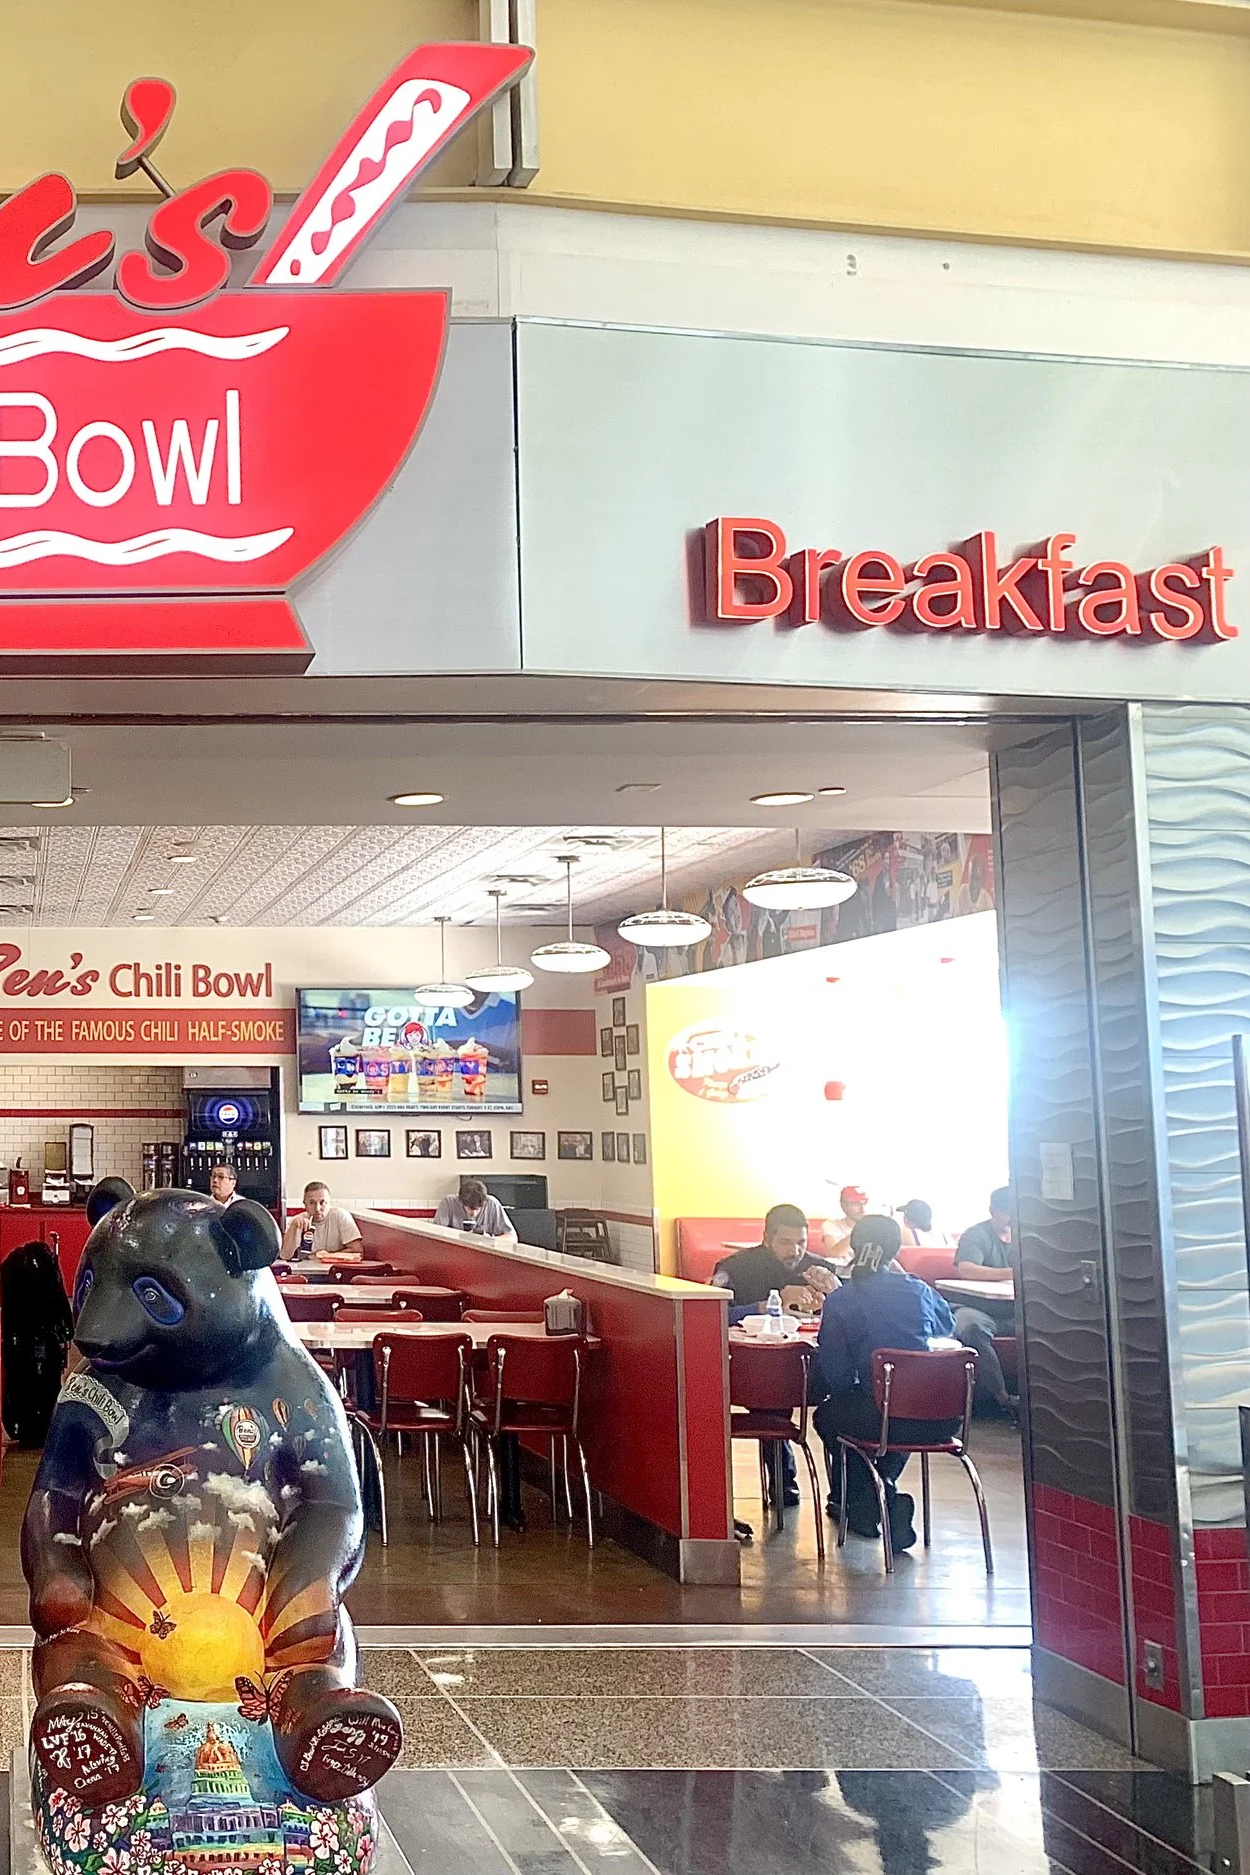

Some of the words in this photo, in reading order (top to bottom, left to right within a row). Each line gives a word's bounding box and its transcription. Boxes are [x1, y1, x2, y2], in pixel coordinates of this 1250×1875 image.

[713, 515, 1239, 642] Breakfast
[108, 961, 181, 999] Chili
[191, 962, 273, 998] Bowl
[364, 1006, 458, 1027] GOTTA
[8, 1020, 30, 1042] OF
[34, 1020, 64, 1042] THE
[71, 1020, 135, 1042] FAMOUS
[140, 1020, 179, 1042] CHILI
[188, 1020, 285, 1042] HALF-SMOKE
[362, 1027, 396, 1047] BE
[87, 1386, 106, 1407] Chili
[103, 1398, 125, 1425] Bowl
[70, 1729, 87, 1742] '16
[72, 1743, 91, 1760] '17
